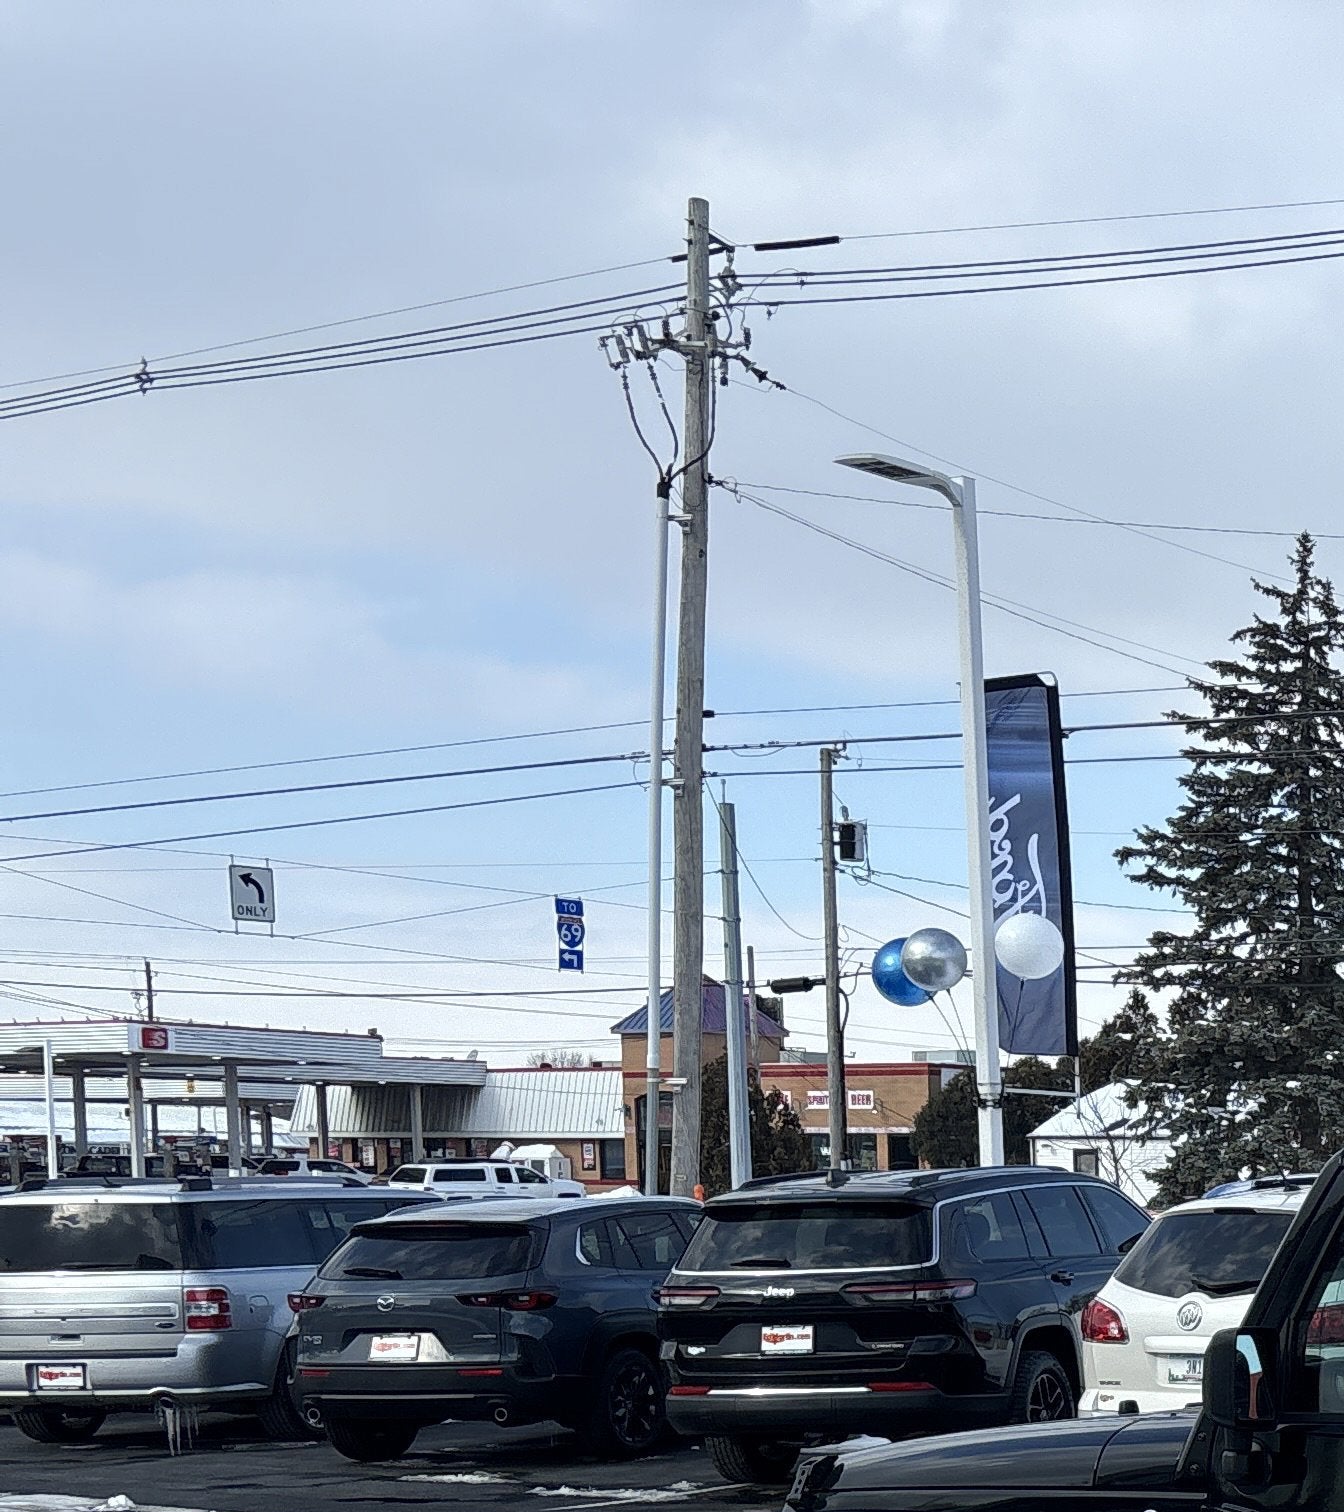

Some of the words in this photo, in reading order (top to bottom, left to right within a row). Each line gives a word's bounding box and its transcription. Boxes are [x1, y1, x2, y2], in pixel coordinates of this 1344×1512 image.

[236, 904, 269, 918] ONLY
[561, 901, 577, 913] TO
[560, 924, 582, 943] 69
[850, 1093, 872, 1106] BEER
[763, 1286, 795, 1298] Jeep
